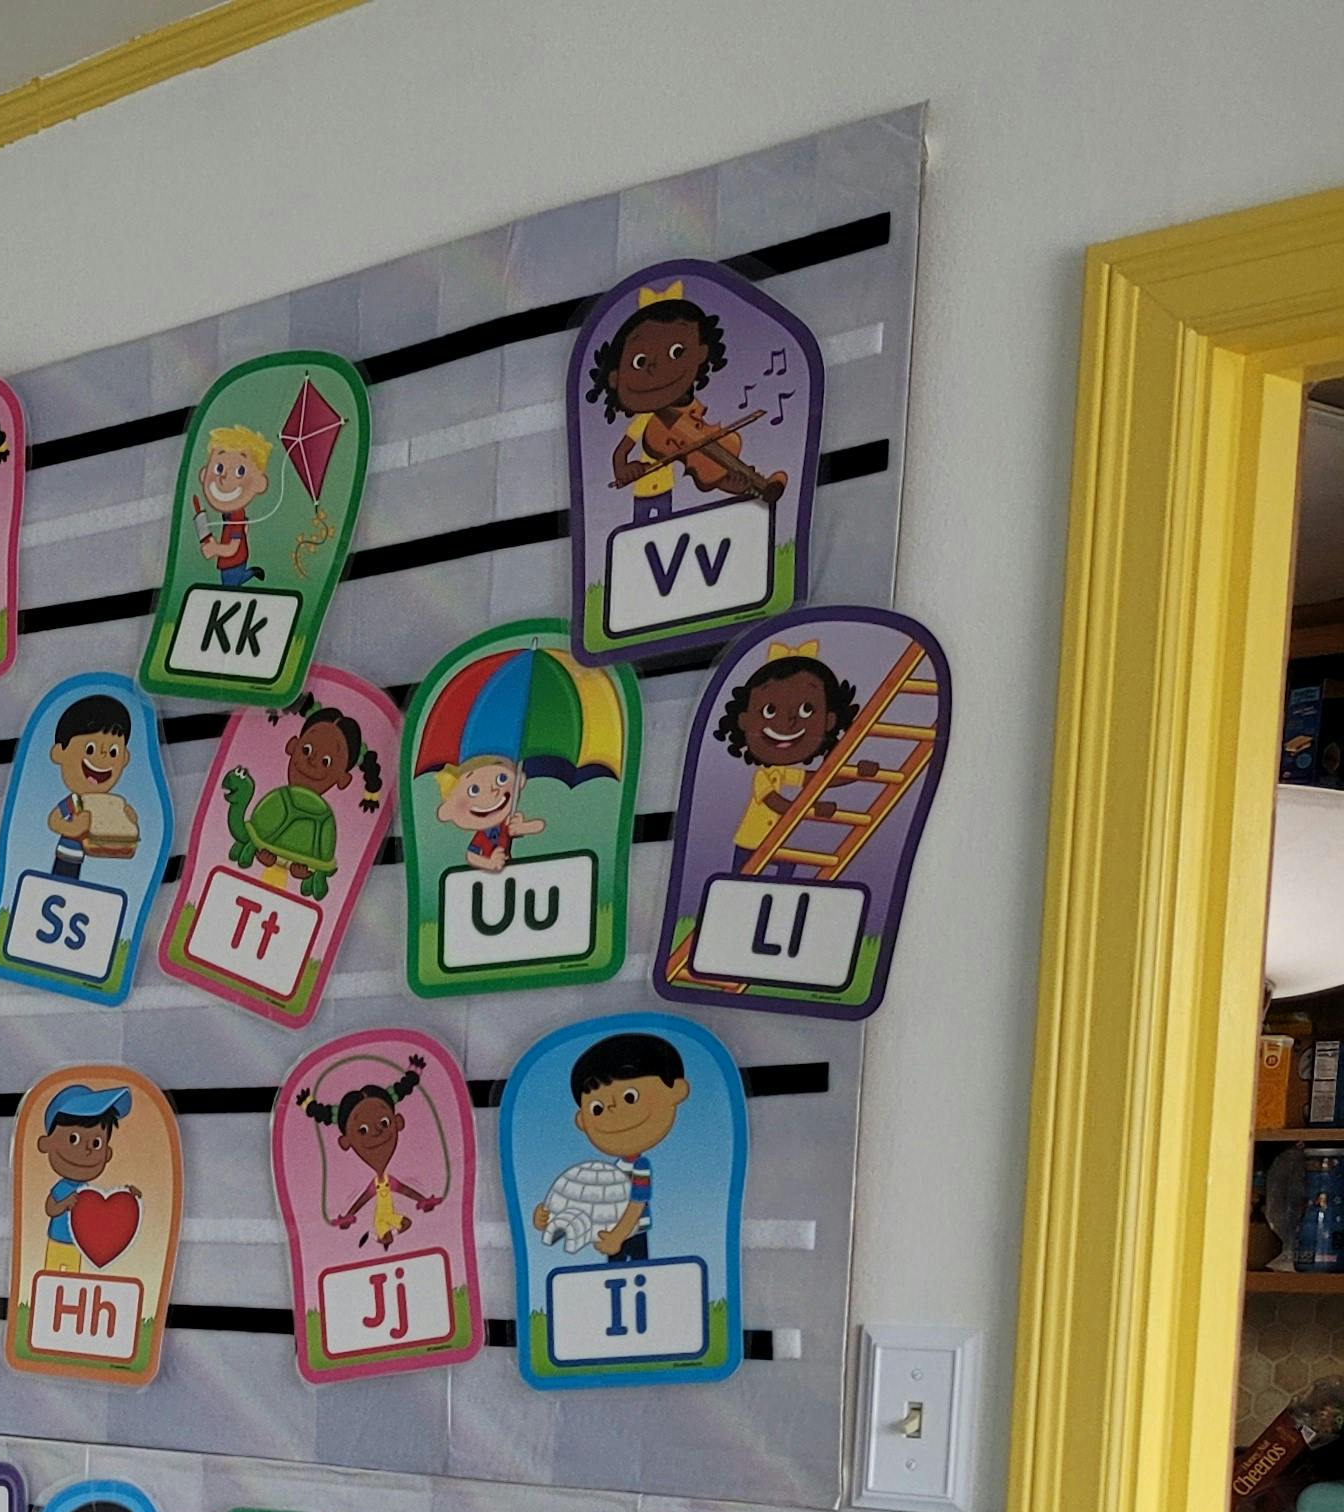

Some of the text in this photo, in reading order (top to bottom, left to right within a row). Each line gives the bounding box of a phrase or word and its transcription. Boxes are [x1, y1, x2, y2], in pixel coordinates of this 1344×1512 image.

[644, 532, 732, 597] Vv
[200, 598, 268, 658] Kk
[35, 894, 90, 951] Ss
[230, 895, 281, 960] Tt
[471, 877, 560, 937] Uu
[751, 892, 810, 958] Ll
[52, 1284, 117, 1339] Hh
[362, 1267, 409, 1340] Jj
[604, 1273, 648, 1337] Ii
[1232, 1442, 1287, 1496] Cheerios
